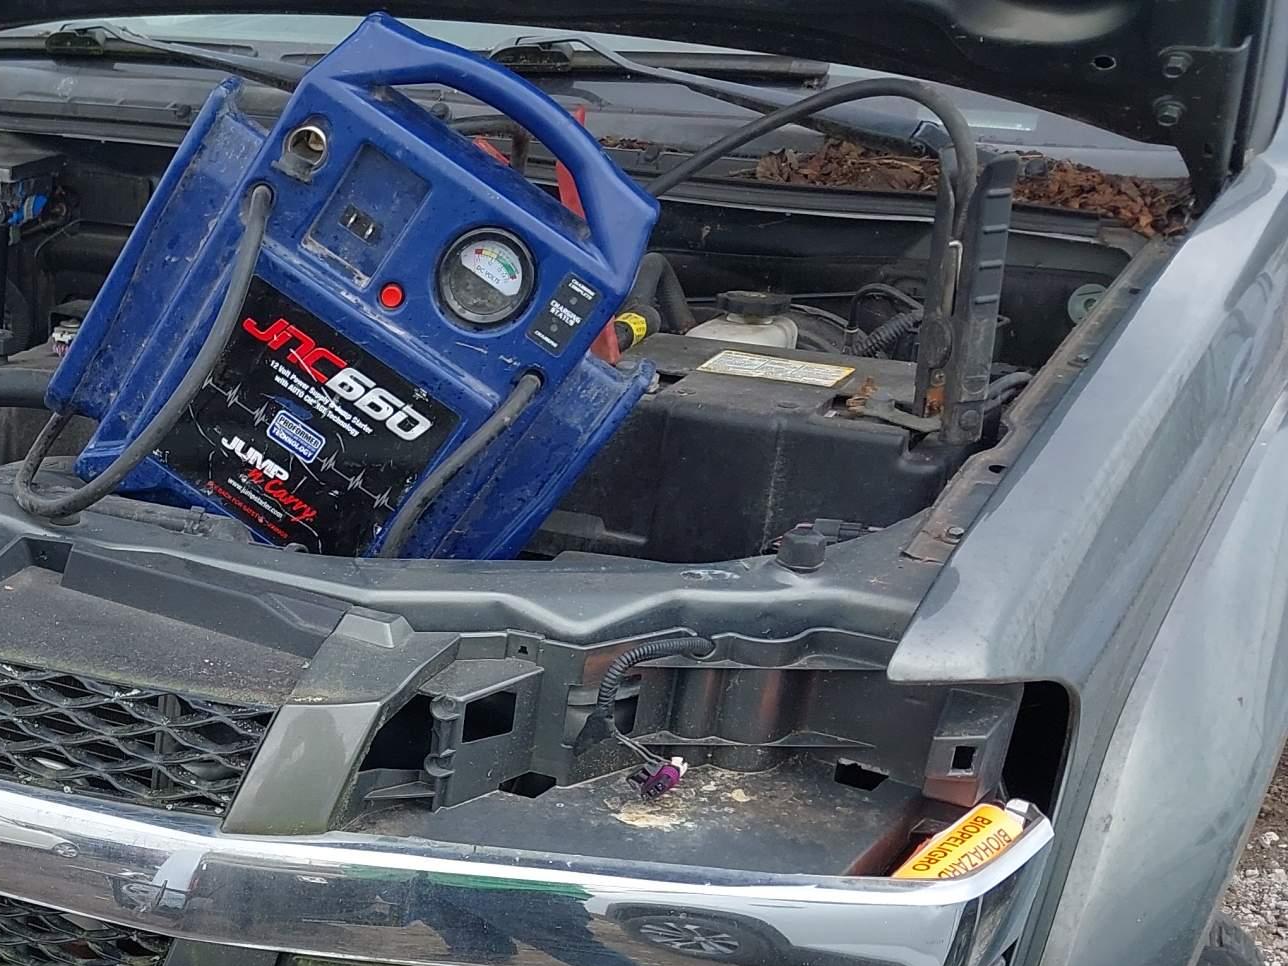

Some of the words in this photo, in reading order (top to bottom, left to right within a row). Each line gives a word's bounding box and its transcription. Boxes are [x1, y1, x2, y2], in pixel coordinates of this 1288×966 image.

[550, 300, 582, 324] CHARGING
[550, 307, 575, 326] STATUS
[270, 360, 279, 370] 12
[277, 365, 292, 378] Volt
[290, 373, 309, 390] Power
[309, 387, 330, 405] Supply
[351, 416, 373, 434] Starter
[274, 375, 289, 388] with
[287, 384, 305, 398] AUTO
[327, 410, 360, 436] Technology
[278, 416, 321, 448] PROFORMER
[220, 435, 290, 481] JUMP
[227, 477, 283, 519] www.jumpstarter.com
[264, 479, 318, 523] Carry
[912, 815, 993, 872] BIOPELIGRO
